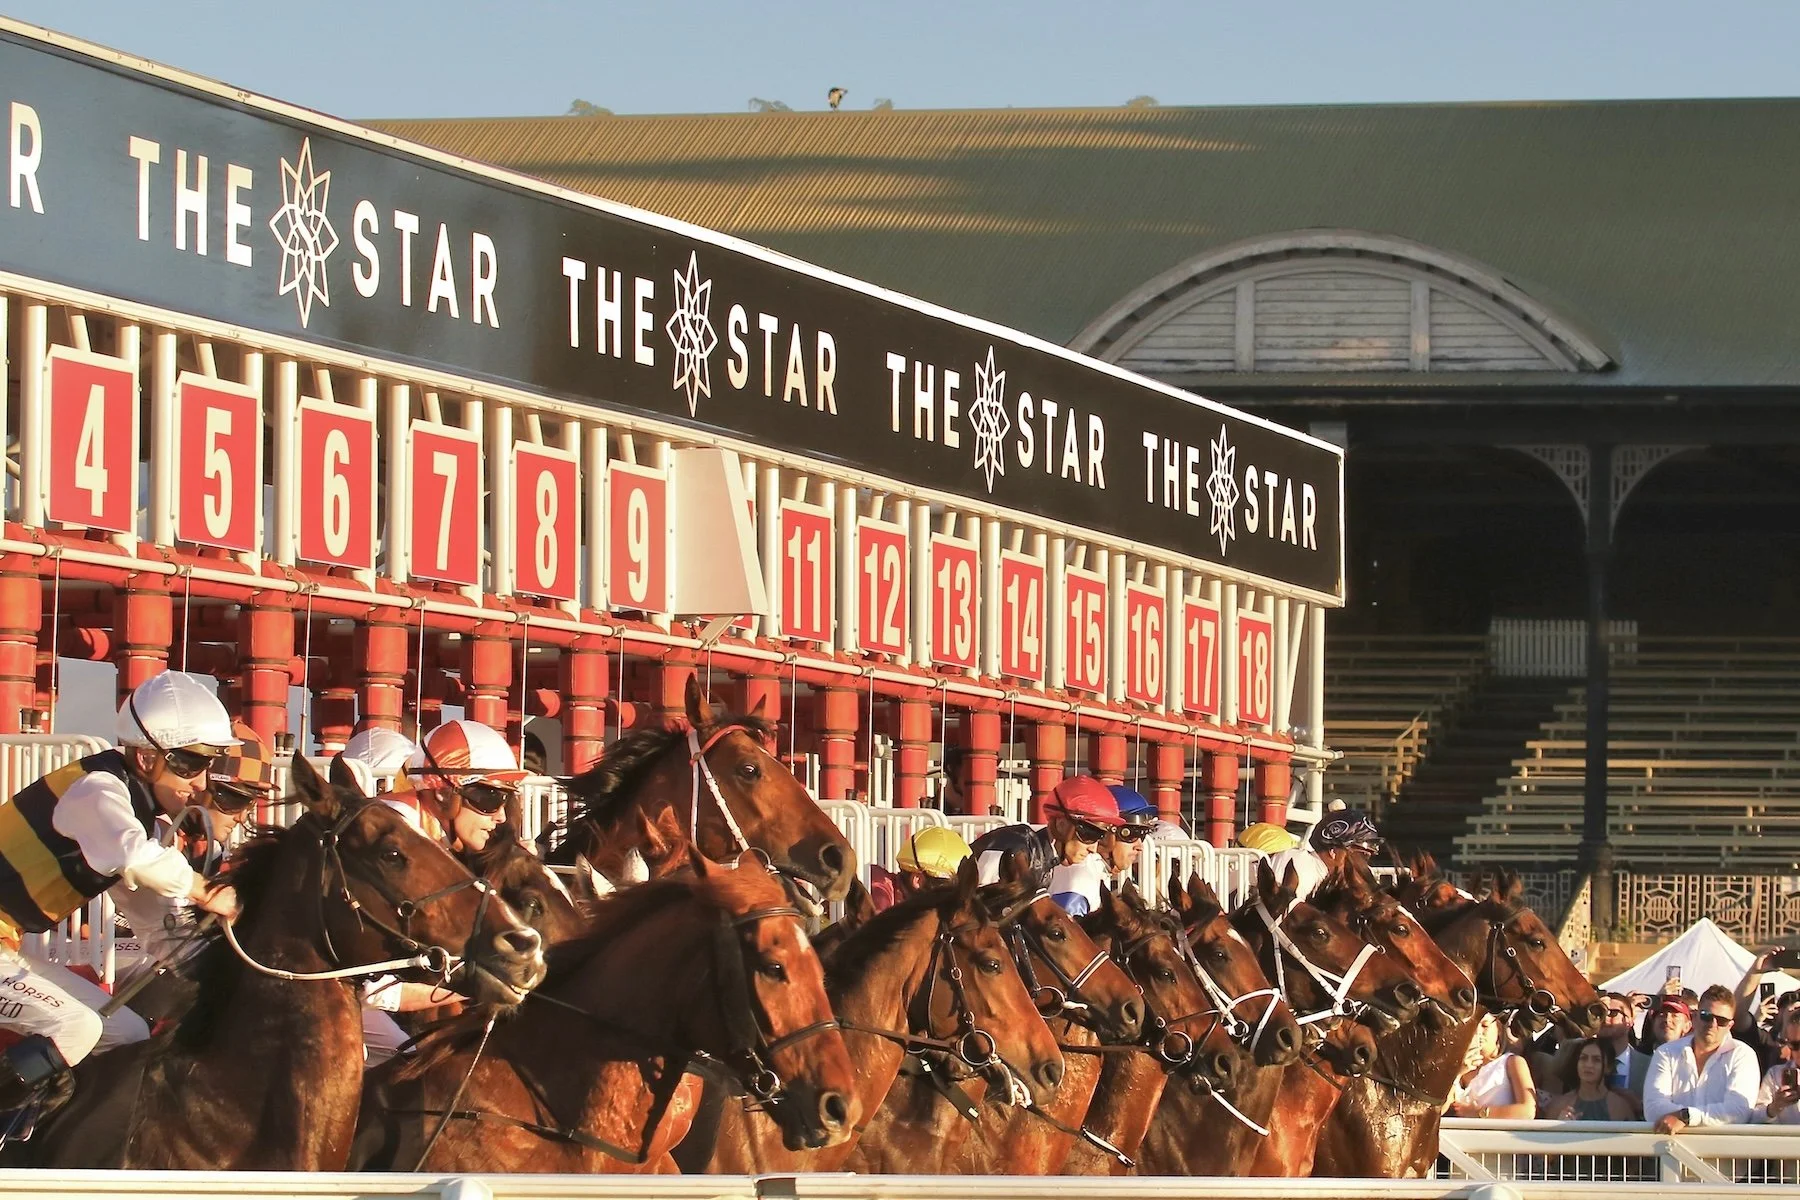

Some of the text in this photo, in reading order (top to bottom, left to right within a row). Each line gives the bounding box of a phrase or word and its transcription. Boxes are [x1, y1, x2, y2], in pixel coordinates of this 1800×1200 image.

[10, 102, 44, 214] R
[129, 136, 499, 328] THE STAR
[563, 257, 837, 415] THE STAR
[75, 384, 108, 517] 4
[204, 406, 232, 538] 5
[887, 352, 1105, 489] THE STAR
[323, 429, 350, 557] 6
[433, 451, 457, 571] 7
[535, 470, 558, 589] 8
[628, 488, 649, 603] 9
[1143, 432, 1316, 550] THE STAR
[788, 526, 821, 632] 11
[865, 543, 901, 647] 12
[938, 558, 971, 660] 13
[1007, 574, 1038, 672] 14
[1072, 590, 1100, 686] 15
[1132, 604, 1159, 698] 16
[1189, 618, 1215, 706] 17
[1243, 631, 1267, 718] 18
[2, 977, 64, 1007] HORSES
[114, 942, 141, 951] SES
